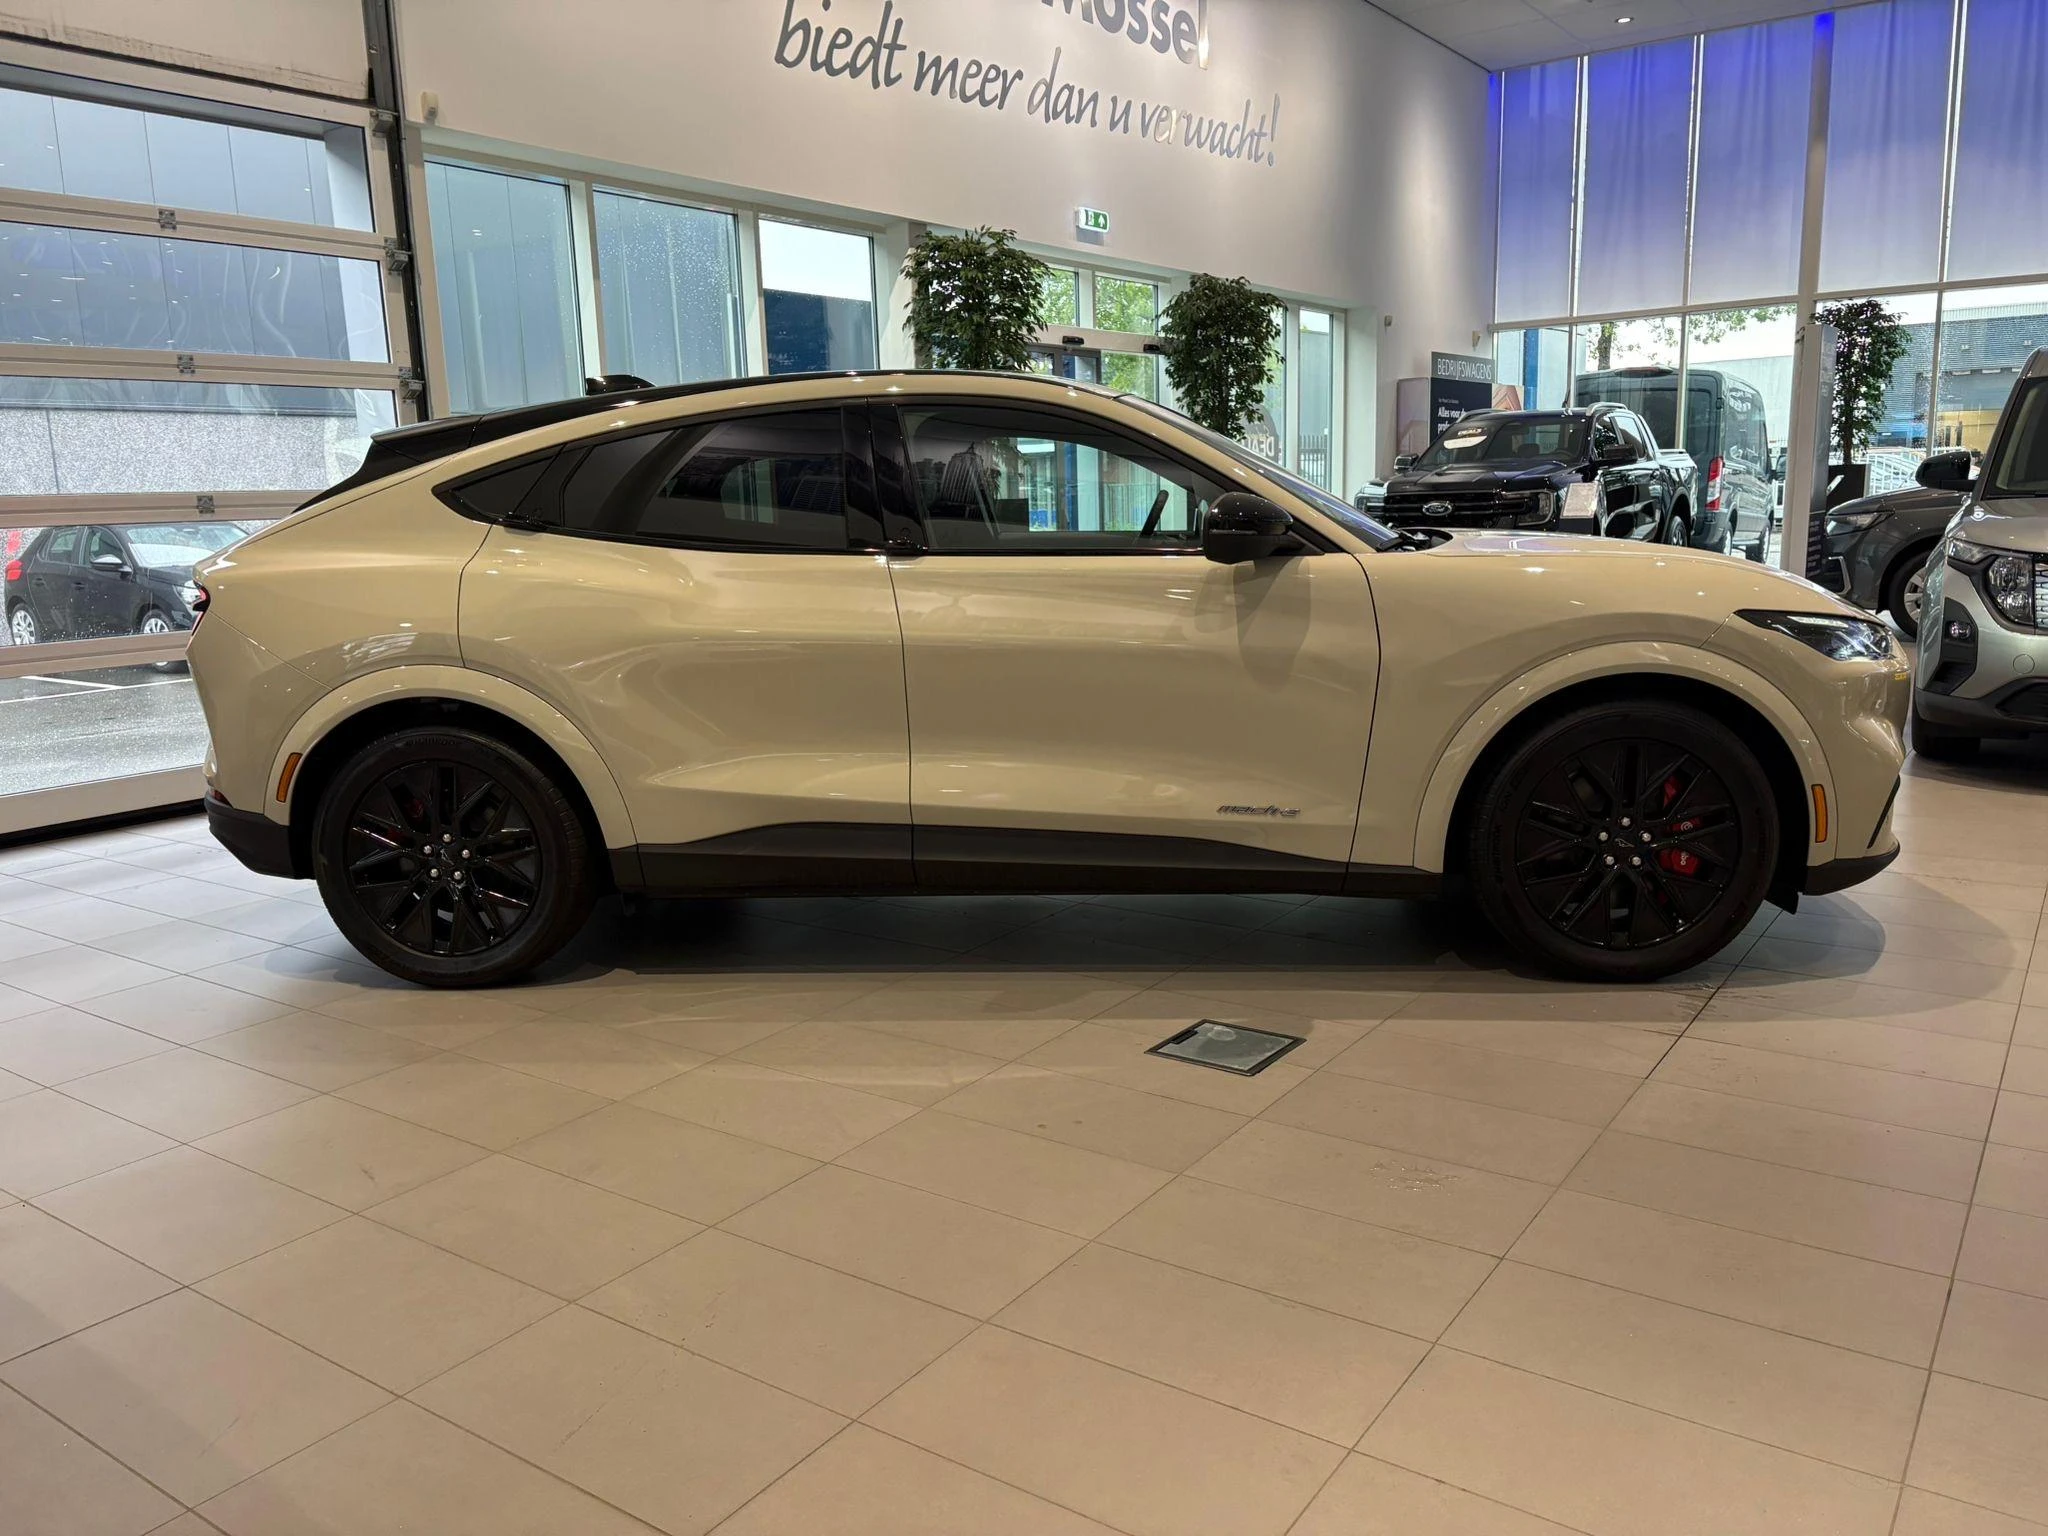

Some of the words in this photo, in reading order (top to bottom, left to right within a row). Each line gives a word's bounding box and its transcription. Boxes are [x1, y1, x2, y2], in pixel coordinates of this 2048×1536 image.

[774, 0, 907, 89] biedt
[913, 50, 1024, 110] meer
[1026, 47, 1099, 128] dan
[1109, 96, 1131, 134] u
[1140, 94, 1281, 167] verwacht!
[1437, 358, 1492, 380] BEDRIJFSWAGENS
